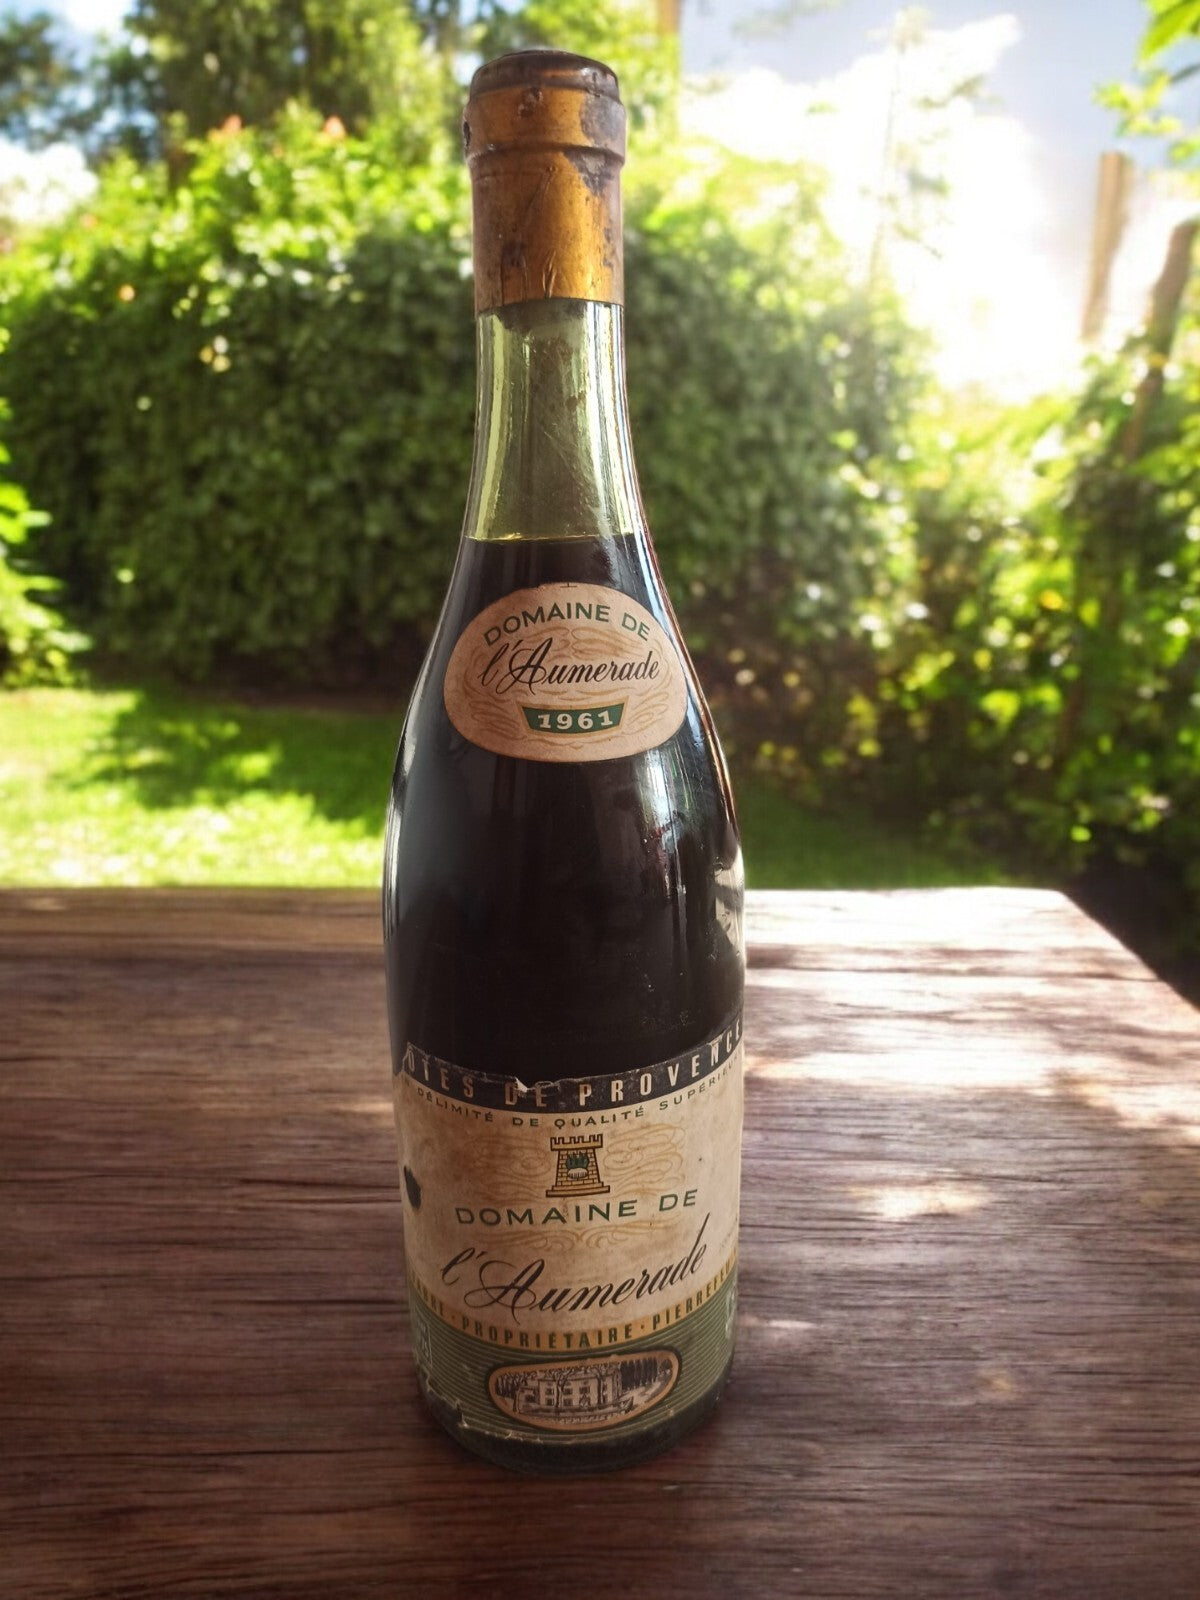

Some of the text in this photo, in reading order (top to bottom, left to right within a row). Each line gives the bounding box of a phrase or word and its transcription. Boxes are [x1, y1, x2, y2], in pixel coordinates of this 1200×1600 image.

[483, 602, 651, 647] DOMAINE DE
[477, 637, 660, 695] l'Aumerade
[537, 709, 613, 730] 1961
[417, 1086, 494, 1123] DÉLIMITÉ
[512, 1117, 539, 1127] DE
[554, 1105, 645, 1130] QUALITÉ
[505, 1080, 549, 1108] DE
[455, 1188, 698, 1226] DOMAINE DE
[440, 1211, 711, 1326] l'Aumerade
